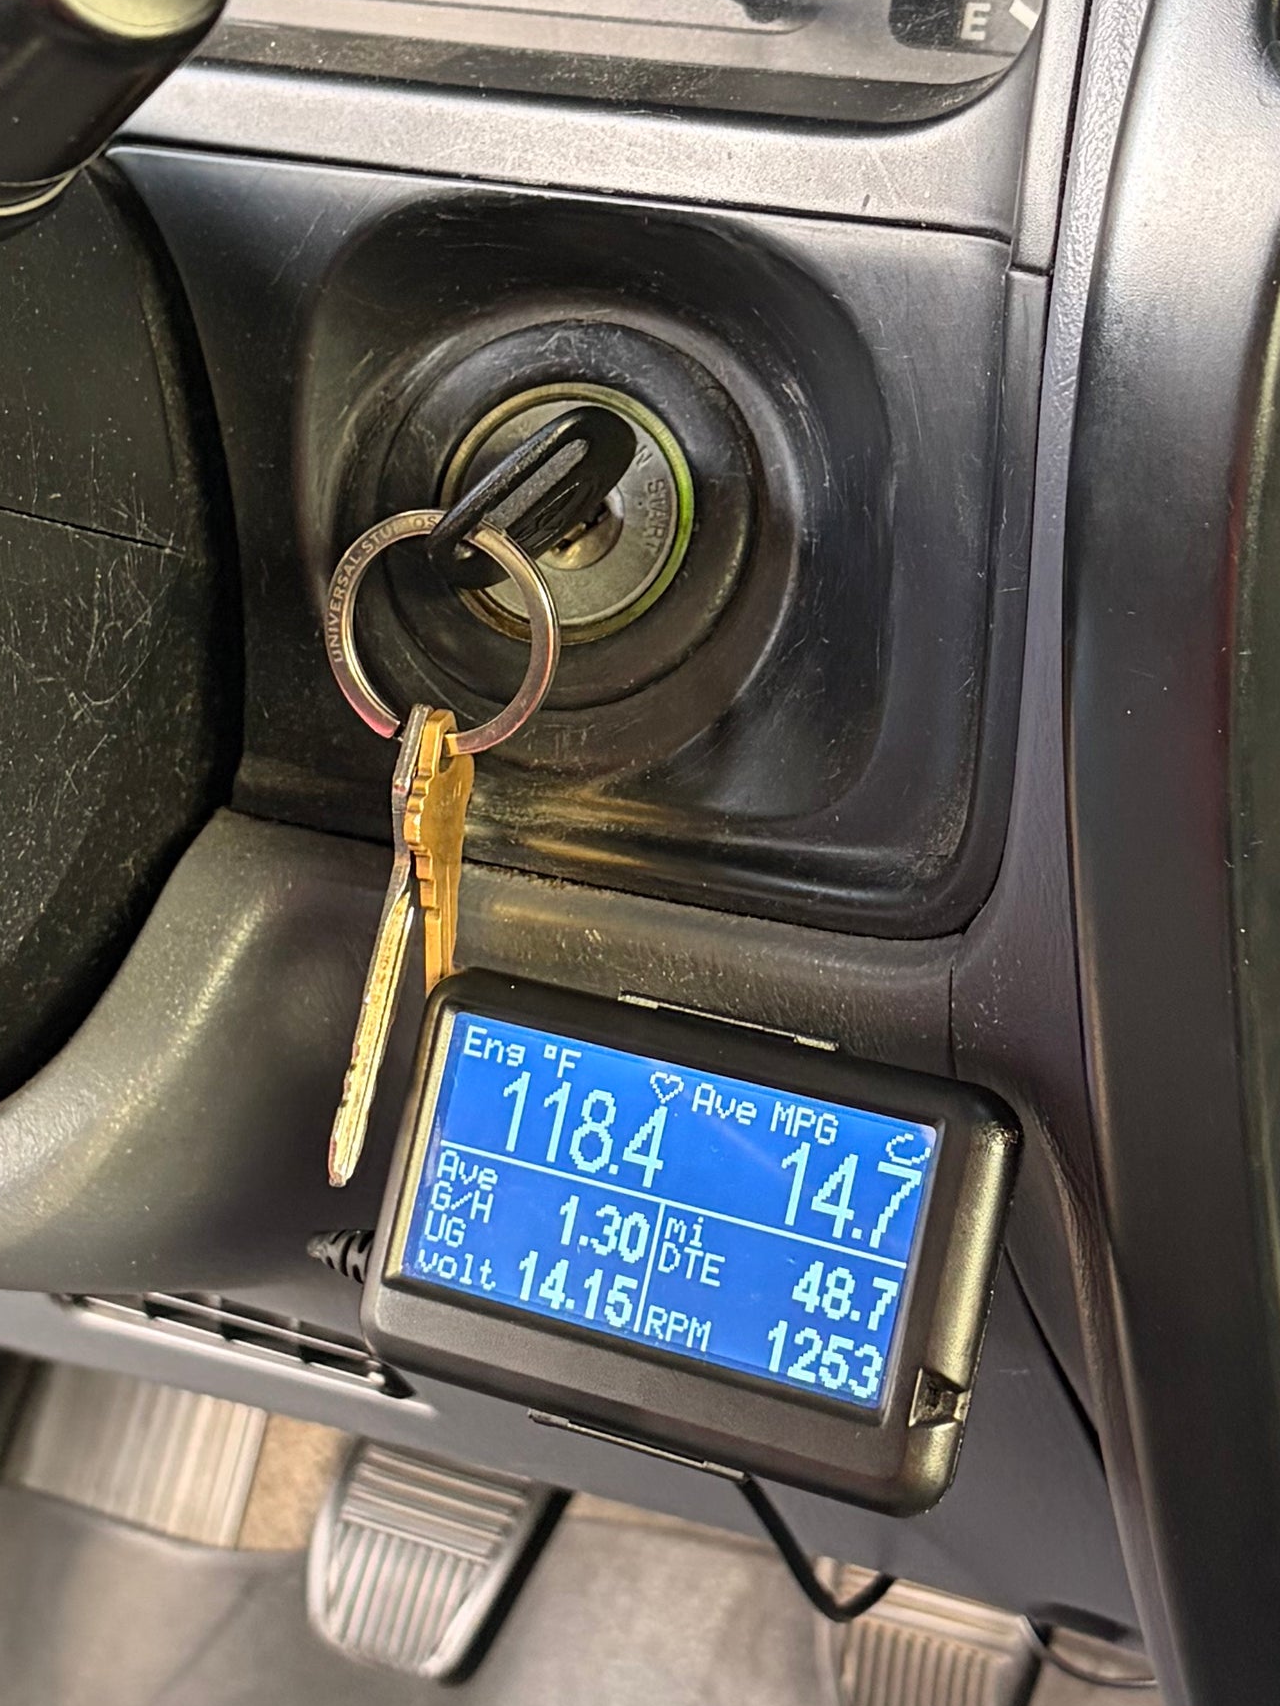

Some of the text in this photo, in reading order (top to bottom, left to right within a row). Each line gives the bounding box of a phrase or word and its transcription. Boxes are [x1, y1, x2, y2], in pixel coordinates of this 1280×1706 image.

[960, 3, 991, 41] E
[643, 478, 672, 556] START
[326, 553, 362, 663] UNIVERSAL
[463, 1025, 526, 1067] Eng
[502, 1070, 669, 1189] 118.4
[692, 1084, 840, 1147] Ave MPG
[436, 1151, 499, 1192] Ave
[781, 1140, 923, 1250] 14.7
[424, 1215, 466, 1248] UG
[431, 1185, 494, 1224] G/H
[559, 1194, 651, 1264] 1.30
[664, 1214, 705, 1249] mi
[417, 1250, 498, 1292] volt
[517, 1249, 640, 1329] 14.15
[659, 1245, 727, 1288] DTE
[791, 1260, 899, 1331] 48.7
[644, 1304, 714, 1353] RPM
[767, 1319, 884, 1398] 1253
